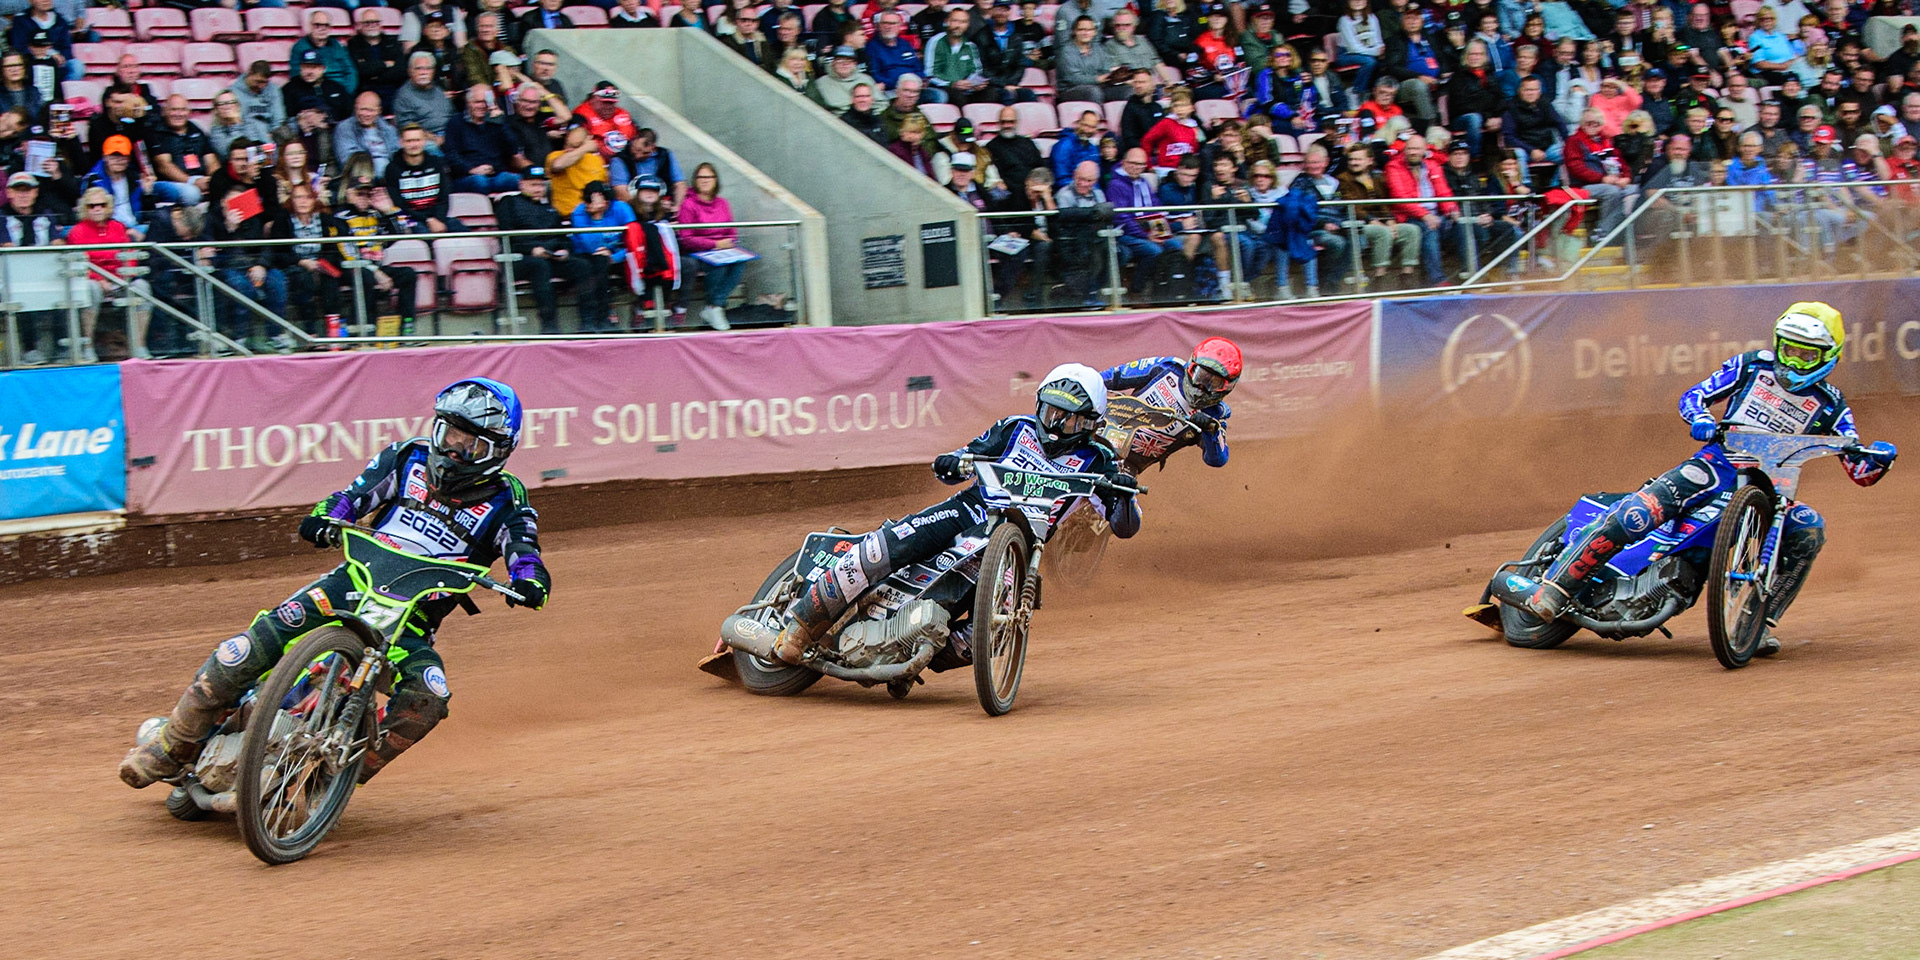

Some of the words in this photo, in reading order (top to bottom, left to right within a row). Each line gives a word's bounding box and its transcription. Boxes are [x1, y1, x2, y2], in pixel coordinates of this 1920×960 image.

[1156, 381, 1177, 408] SPORTS
[1753, 386, 1781, 411] SPORTS
[1779, 399, 1810, 425] INSURE
[1802, 399, 1818, 411] 15
[592, 388, 944, 445] SOLICITORS.CO.UK
[11, 422, 115, 460] Lane
[1004, 473, 1014, 485] R
[1013, 473, 1023, 485] J
[1024, 473, 1070, 491] Warren
[1023, 484, 1044, 497] Ltd
[399, 507, 460, 552] 2022
[1629, 509, 1646, 530] ATPI
[226, 639, 242, 661] ATPI
